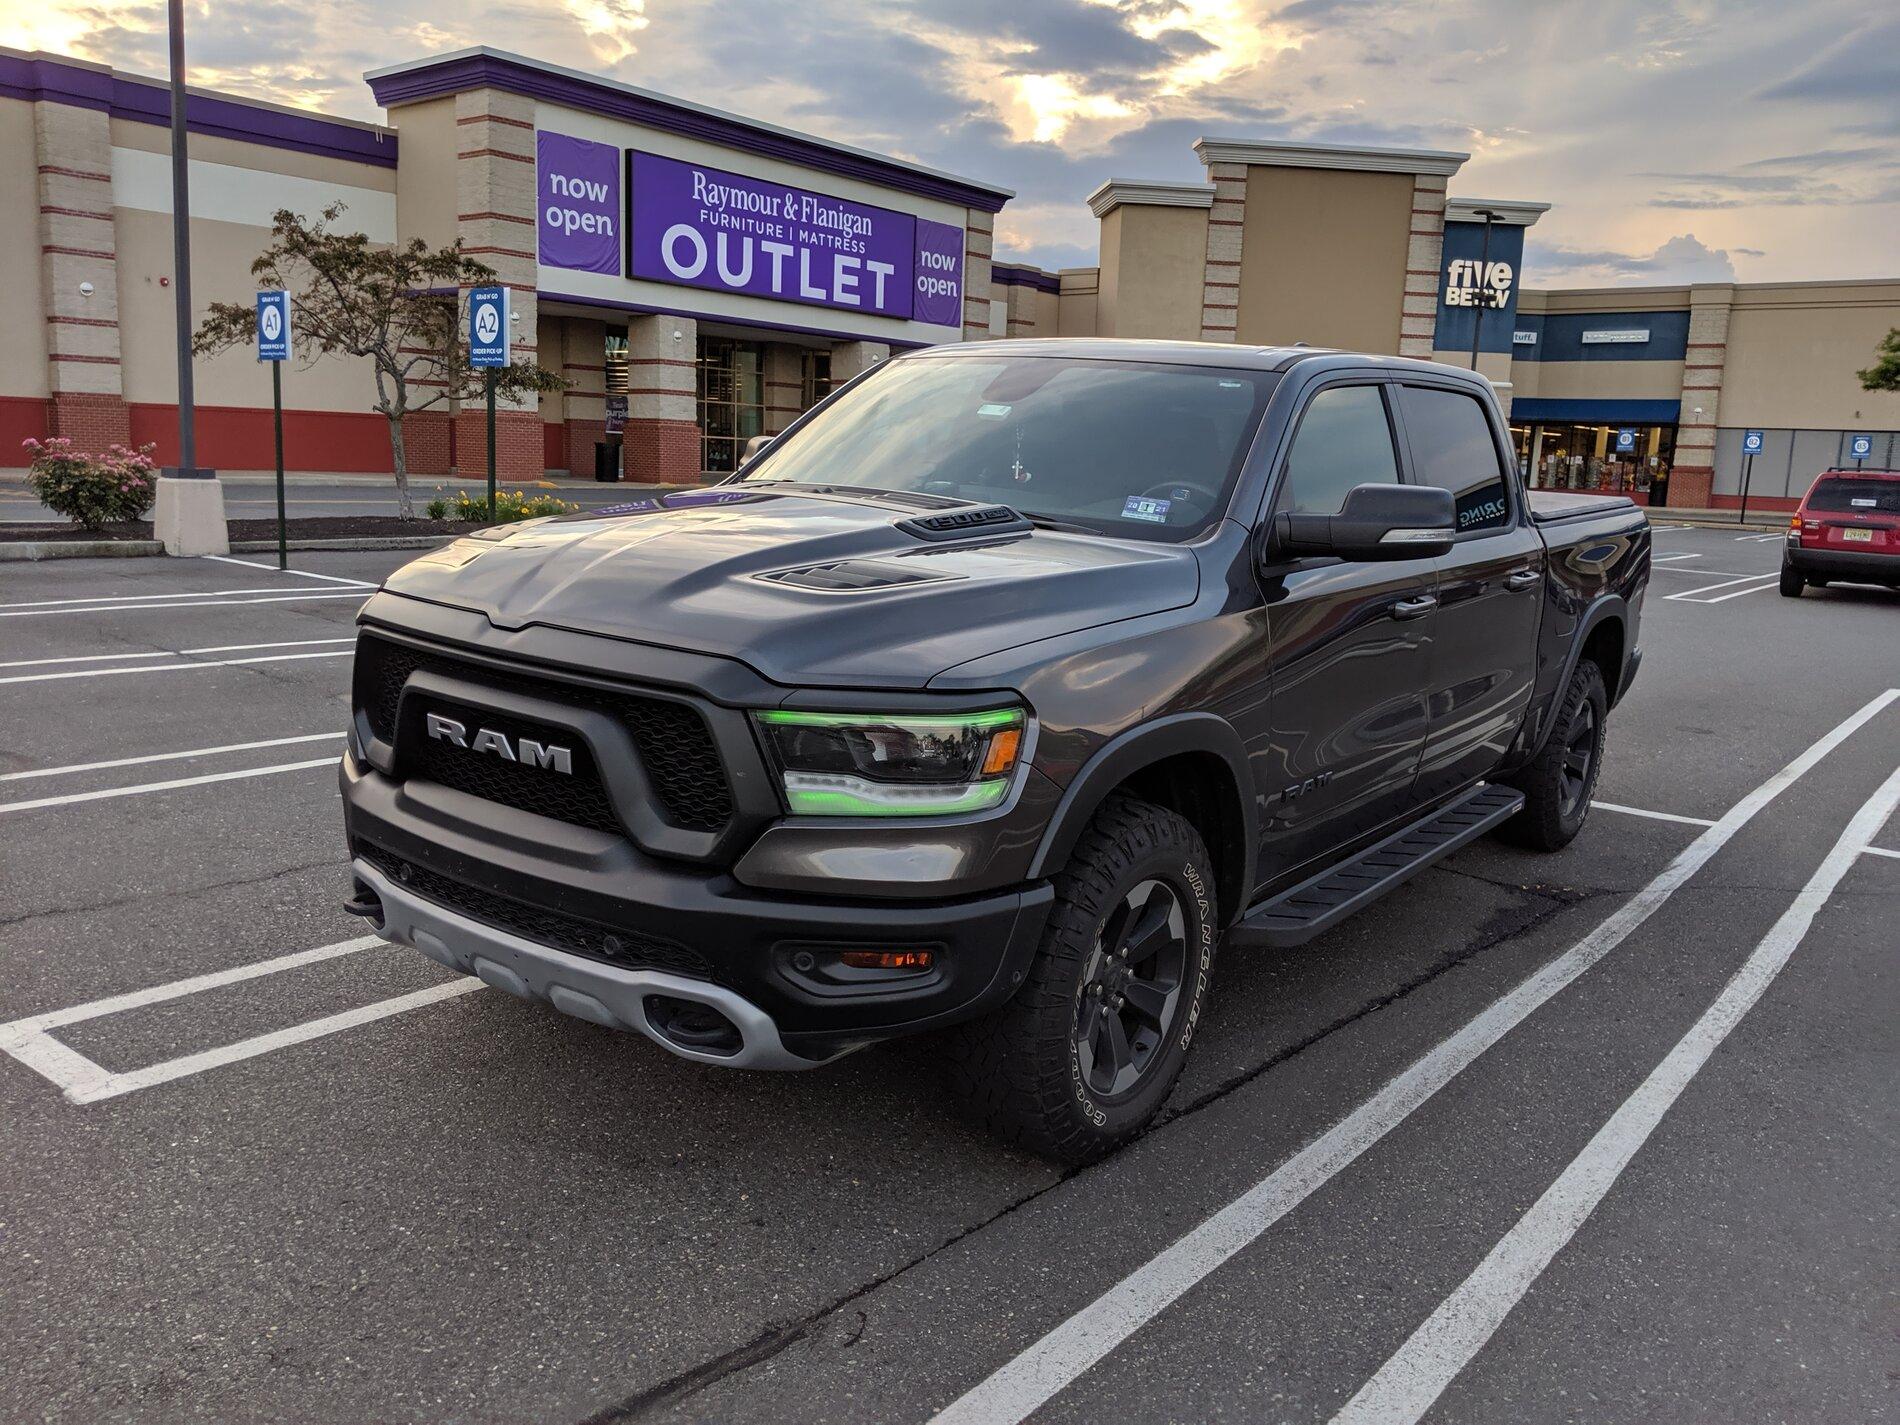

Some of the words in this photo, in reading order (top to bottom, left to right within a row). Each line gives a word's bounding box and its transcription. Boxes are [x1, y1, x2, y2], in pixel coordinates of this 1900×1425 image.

[550, 173, 608, 203] now
[692, 171, 781, 217] Raymour
[783, 193, 798, 221] &
[801, 195, 872, 238] Flanigan
[546, 206, 613, 236] open
[700, 209, 783, 238] FURNITURE
[799, 229, 866, 254] MATTRESS
[661, 223, 895, 309] OUTLET
[921, 250, 956, 271] now
[1448, 259, 1513, 290] five
[917, 275, 957, 298] open
[265, 313, 277, 331] A1
[477, 312, 496, 333] A2
[427, 712, 572, 775] RAM
[1181, 862, 1212, 1051] WRANGLER
